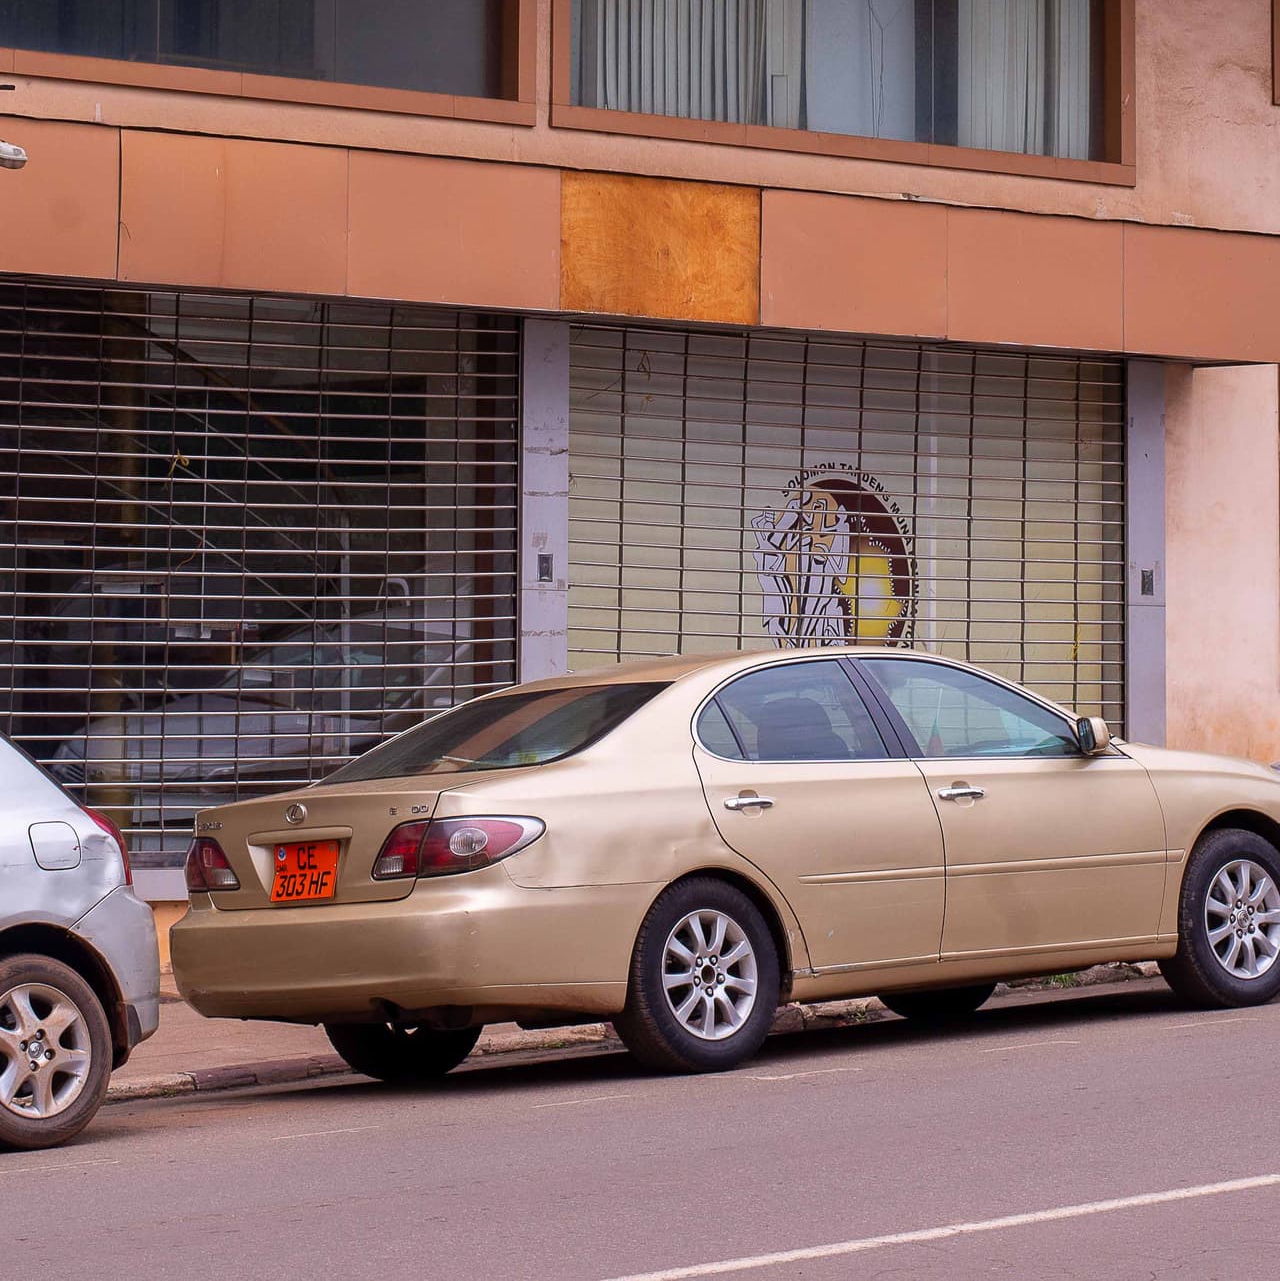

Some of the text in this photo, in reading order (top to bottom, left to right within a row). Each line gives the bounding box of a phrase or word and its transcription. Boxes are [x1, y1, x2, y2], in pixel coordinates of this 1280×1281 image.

[297, 845, 317, 870] CE
[276, 870, 331, 897] 303 HF
